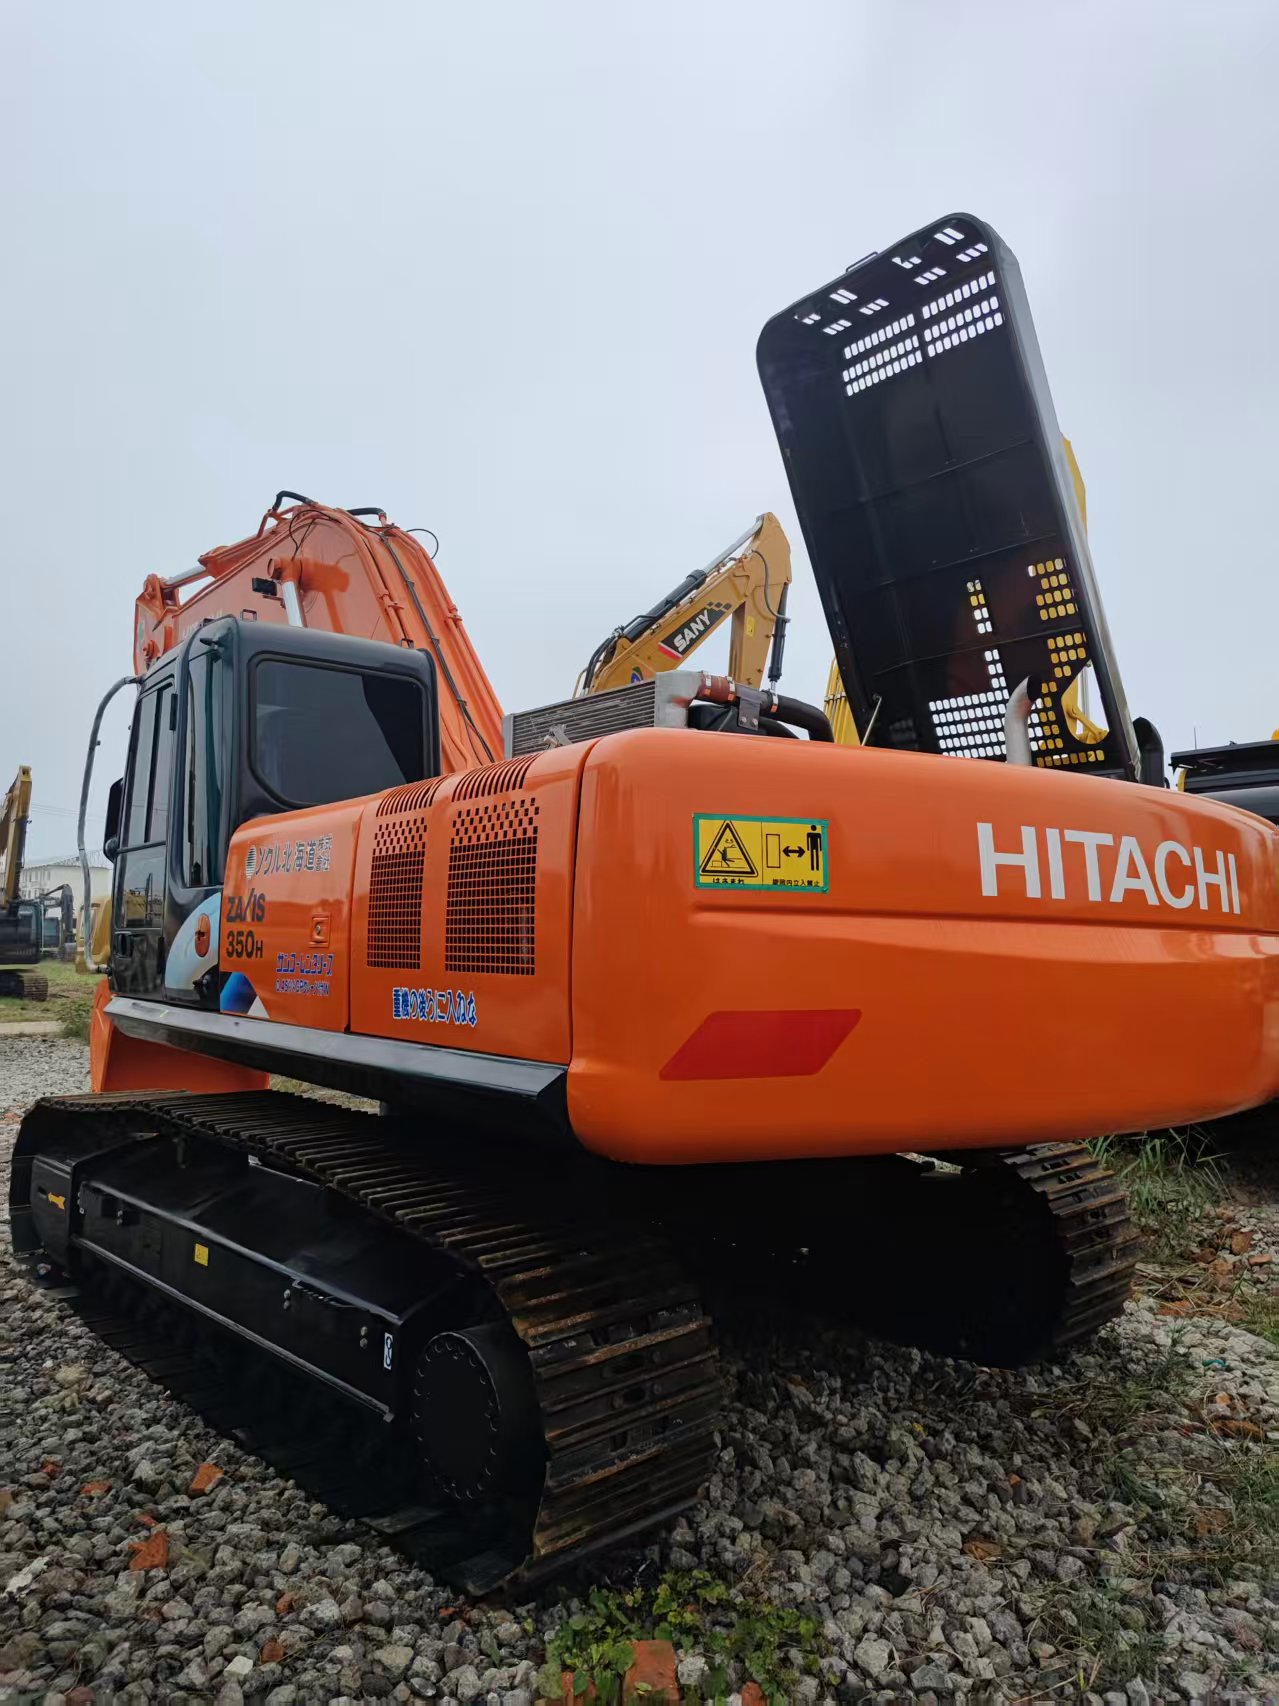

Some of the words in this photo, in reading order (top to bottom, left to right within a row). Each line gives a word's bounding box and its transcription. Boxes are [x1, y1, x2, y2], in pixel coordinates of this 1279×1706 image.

[673, 609, 711, 652] SANY
[976, 822, 1241, 915] HITACHI
[226, 930, 264, 959] 350H
